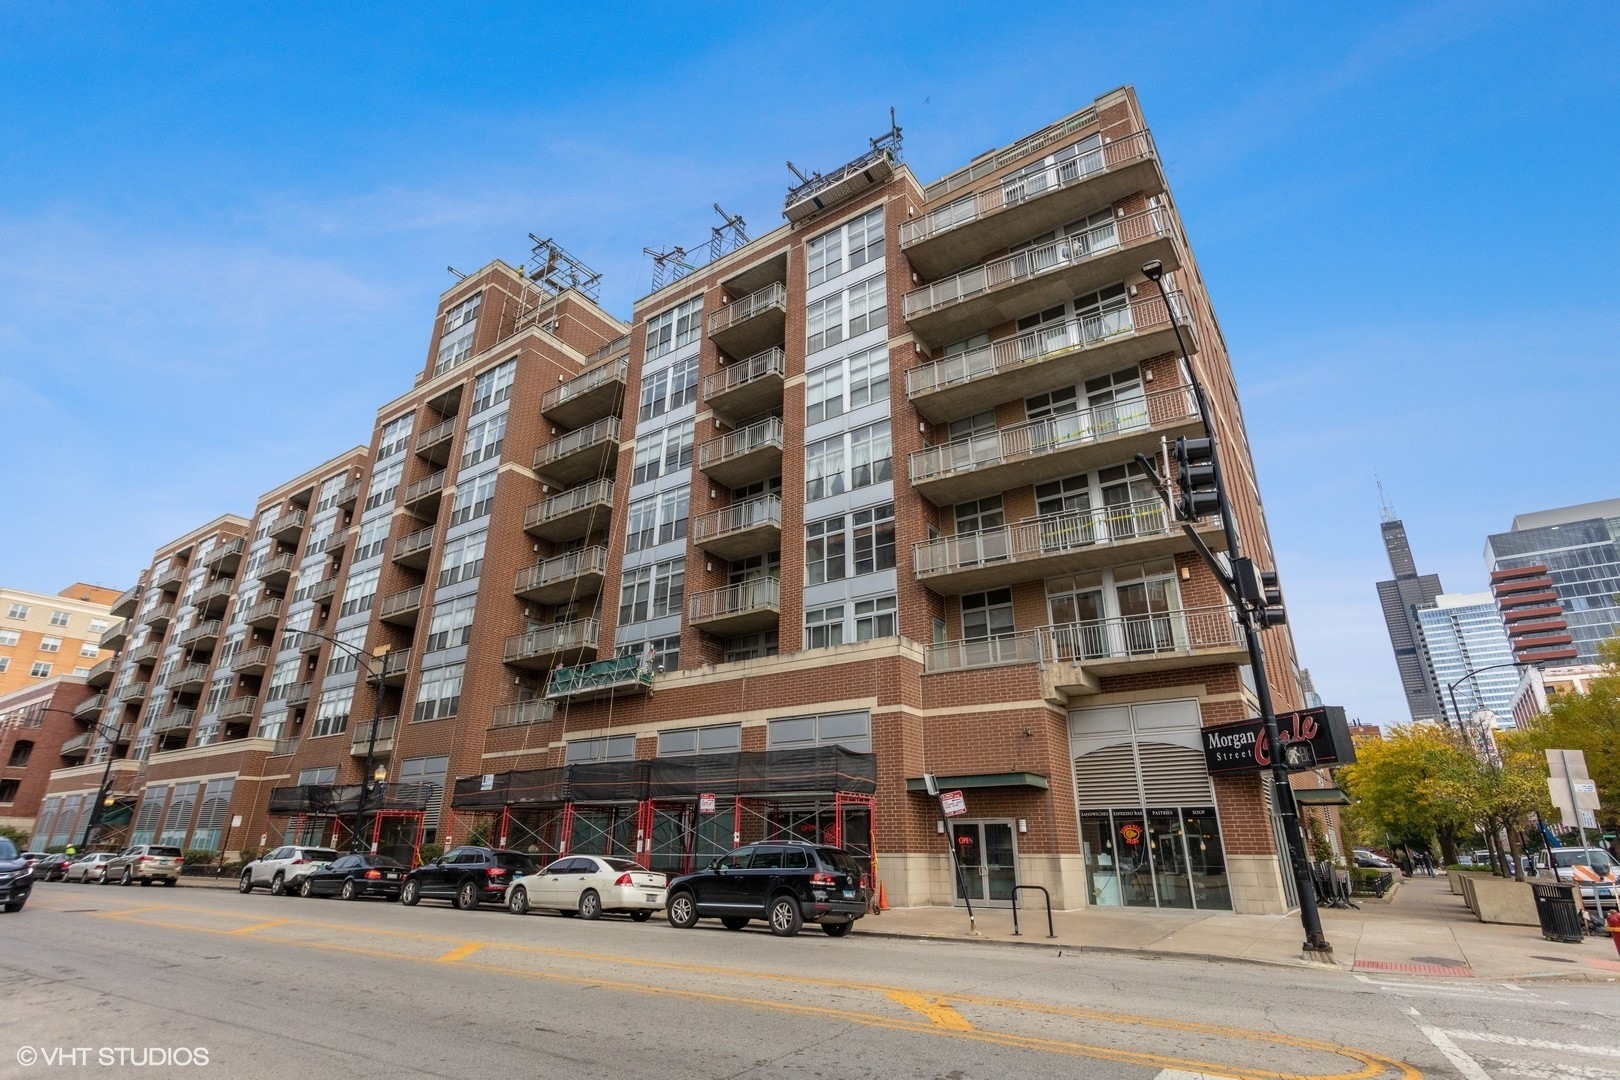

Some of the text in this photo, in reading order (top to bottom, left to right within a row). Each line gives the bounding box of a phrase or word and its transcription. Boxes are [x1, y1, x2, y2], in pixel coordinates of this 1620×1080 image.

[1208, 731, 1256, 749] Morgan
[1216, 749, 1253, 762] Street
[958, 836, 974, 844] OPEN
